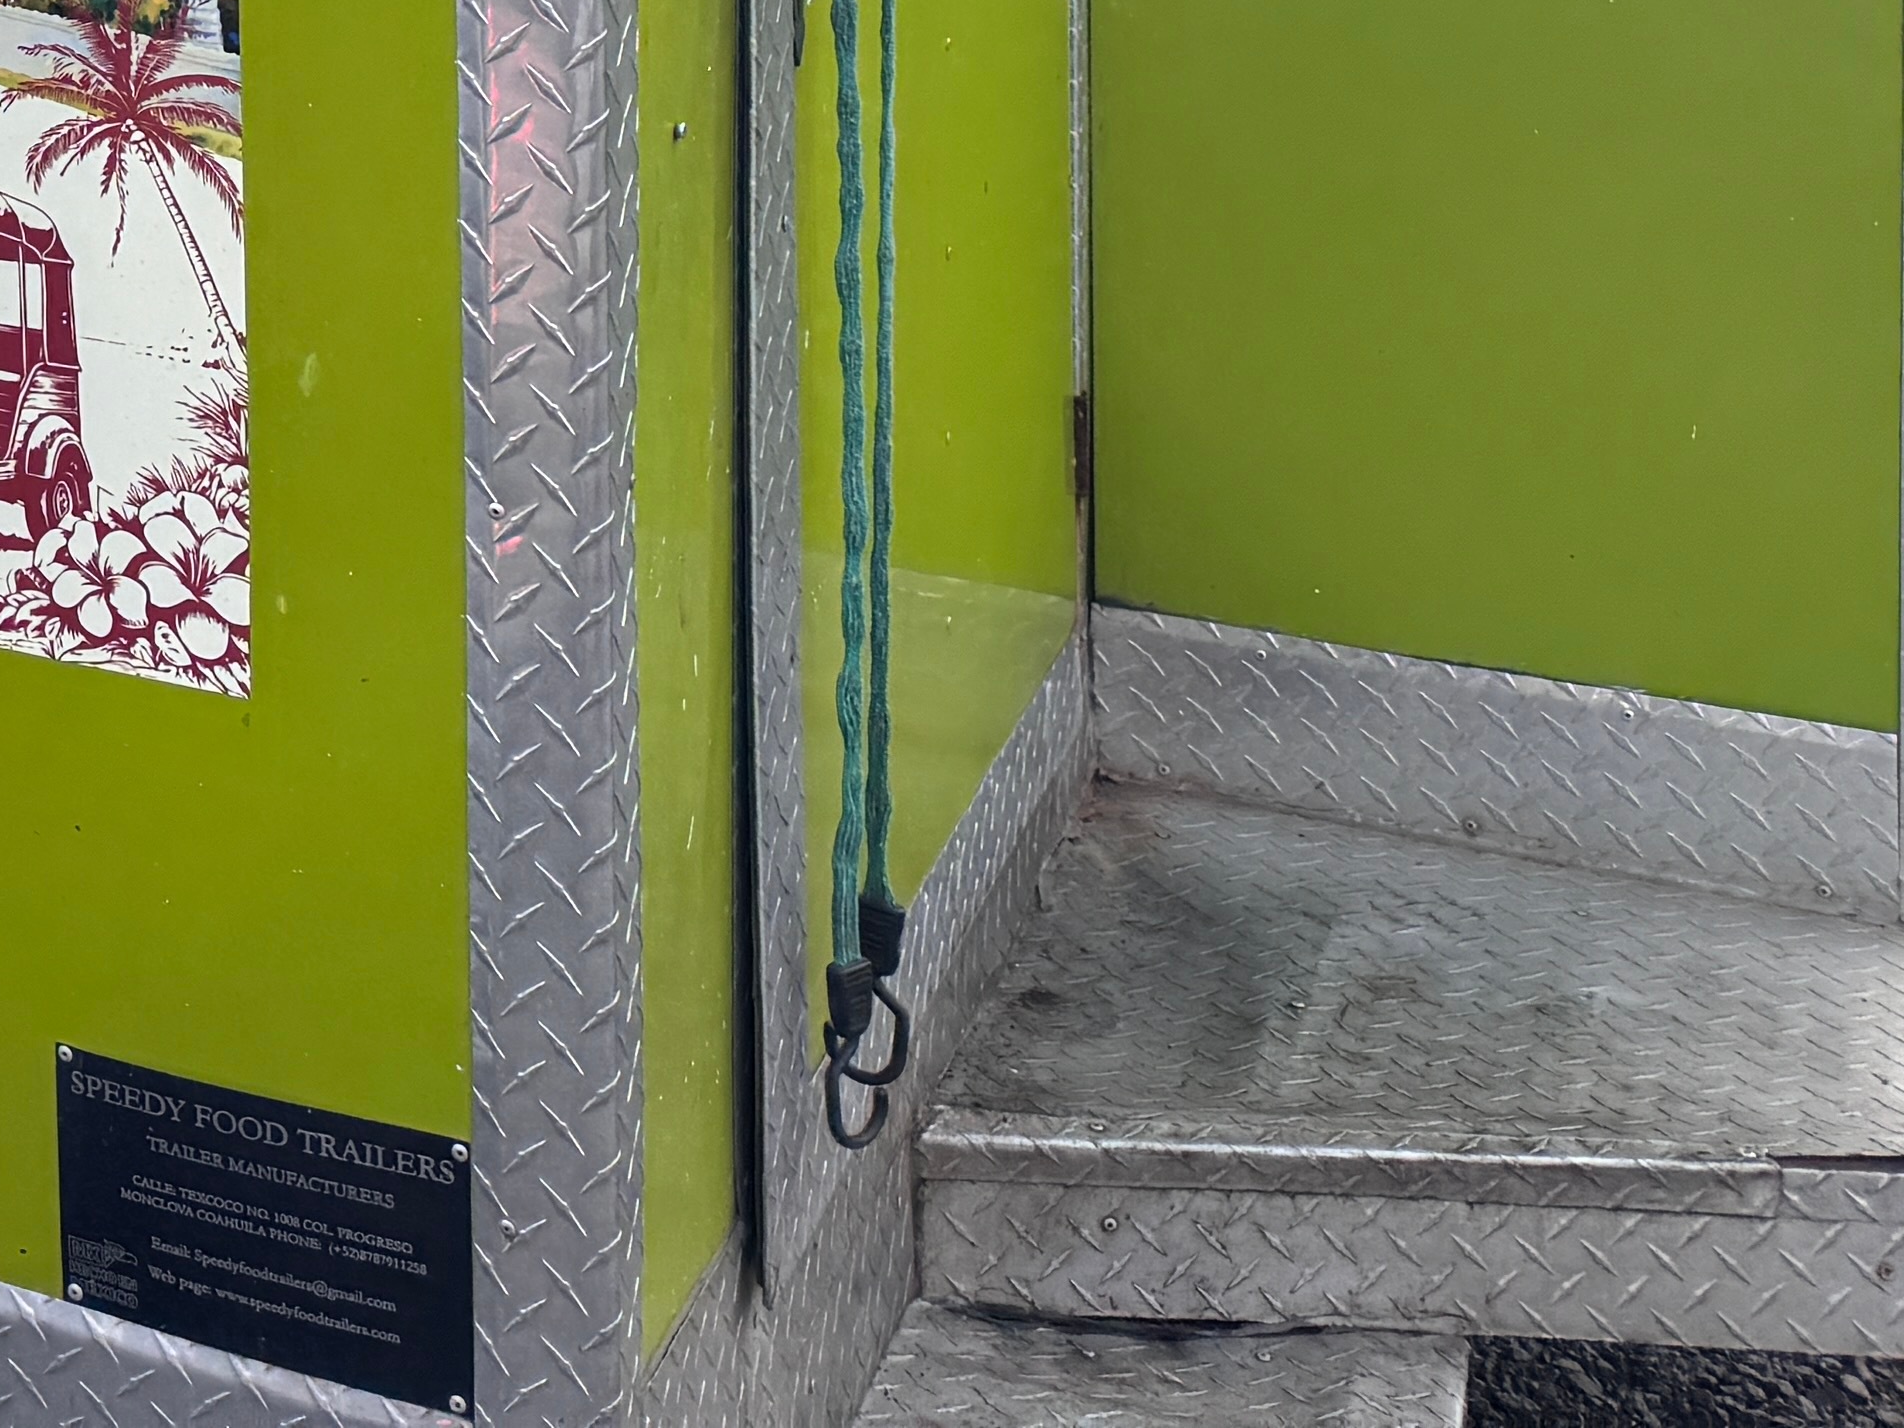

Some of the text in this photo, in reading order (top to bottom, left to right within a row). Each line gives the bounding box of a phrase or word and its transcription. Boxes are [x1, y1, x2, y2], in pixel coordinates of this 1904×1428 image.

[71, 1070, 456, 1184] SPEEDY FOOD TRAILERS
[150, 1136, 395, 1208] TRAILER MANUFACTURERS
[148, 1264, 176, 1283] Web
[179, 1277, 212, 1297] page:
